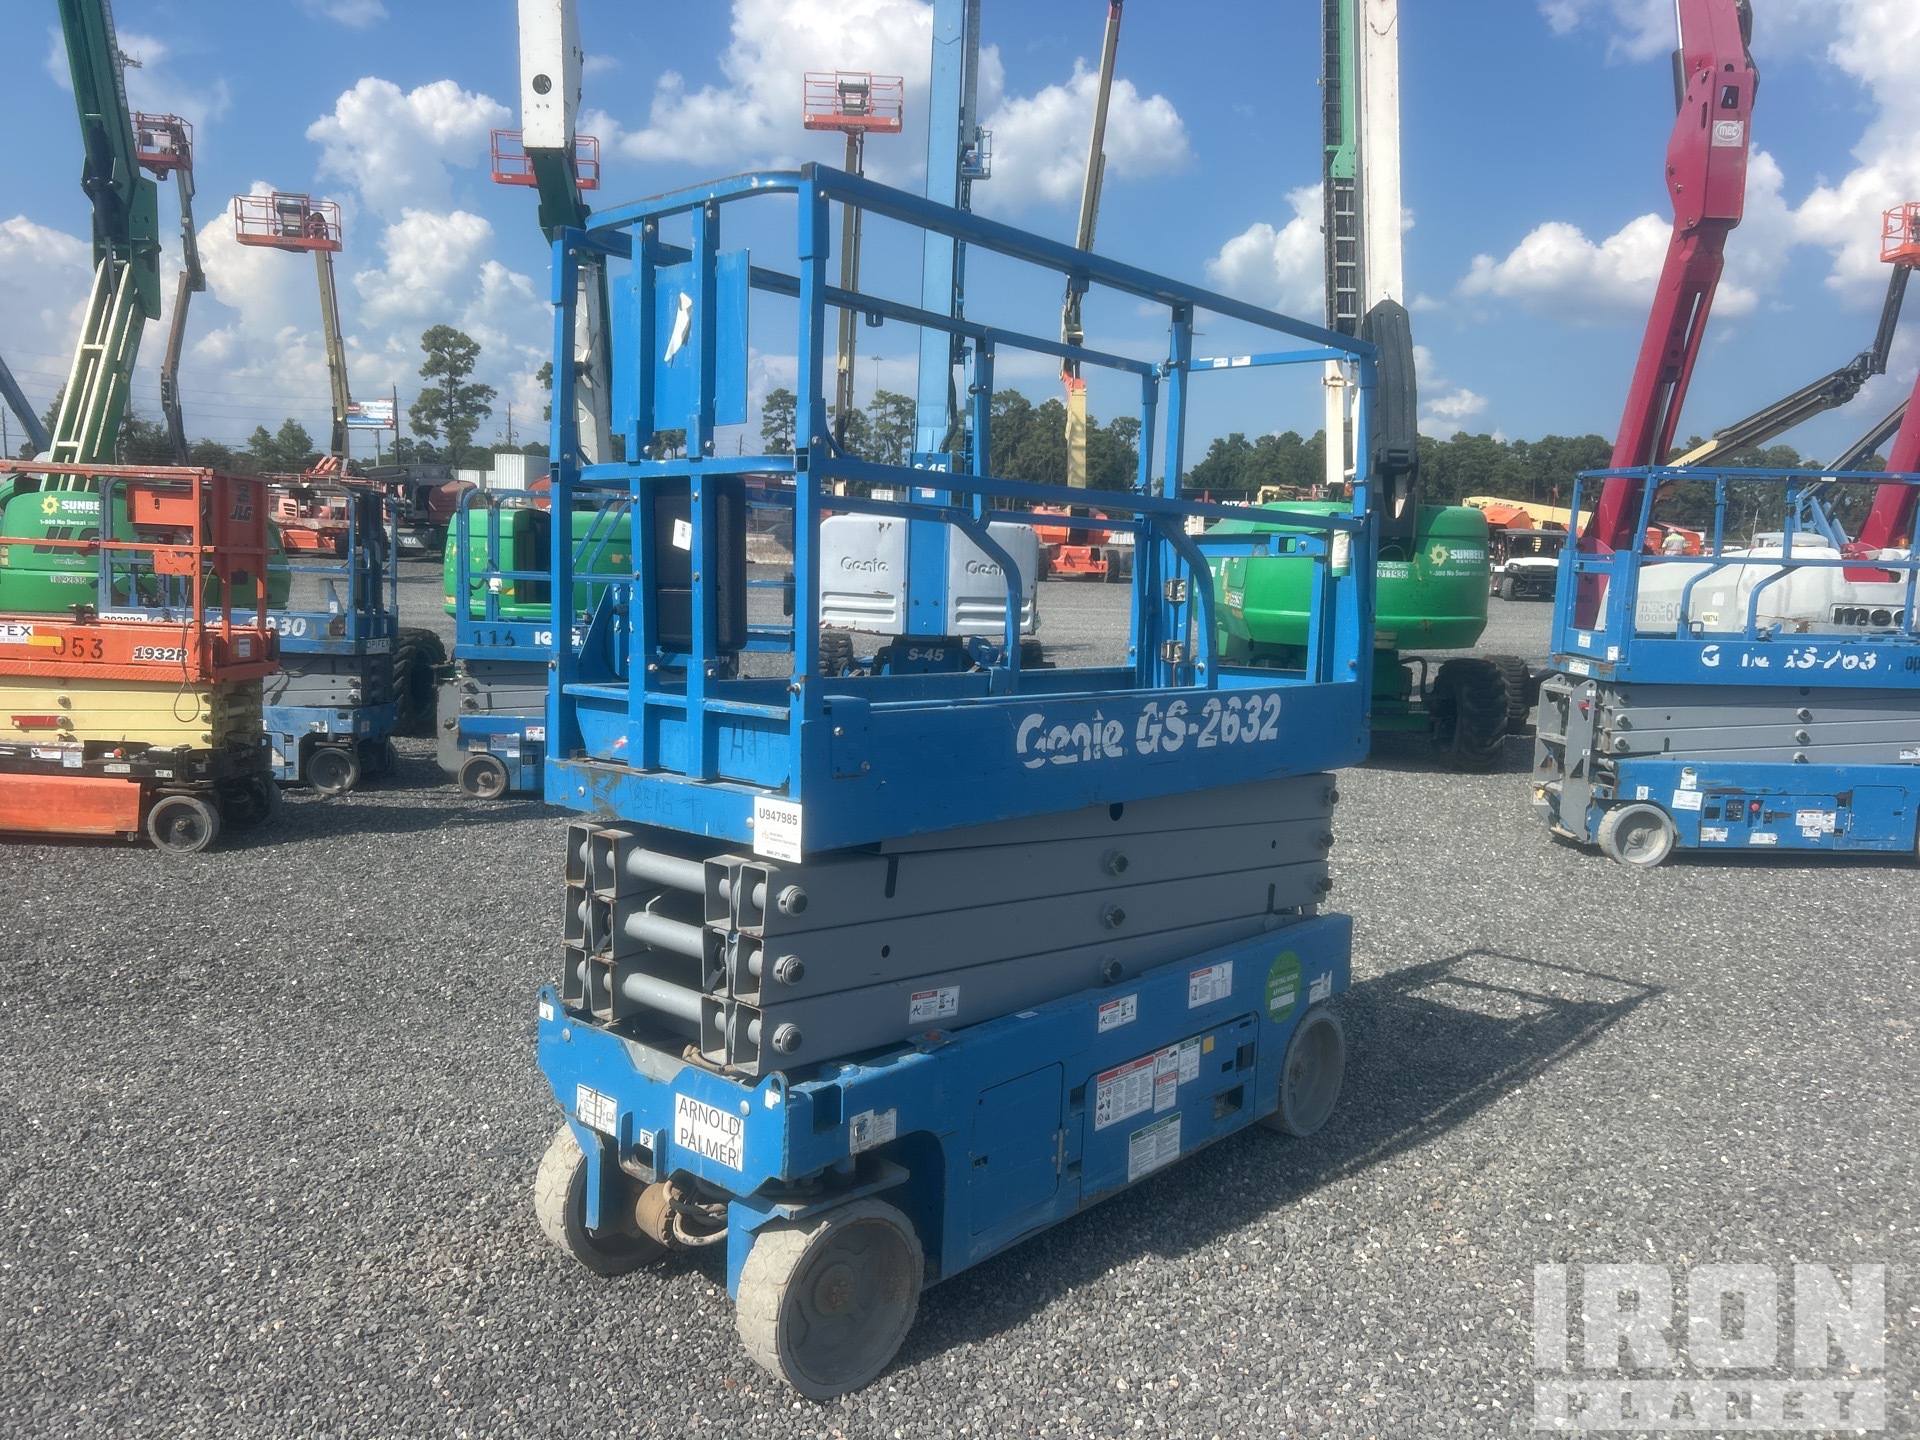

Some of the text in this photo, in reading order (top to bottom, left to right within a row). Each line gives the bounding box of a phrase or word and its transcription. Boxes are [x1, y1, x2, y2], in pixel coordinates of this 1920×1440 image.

[914, 463, 947, 474] S45
[61, 500, 100, 510] SUNBE
[230, 504, 253, 522] JLG
[1450, 549, 1485, 560] SUNBELT
[840, 556, 889, 573] Genie
[965, 559, 1004, 577] Geni
[366, 639, 390, 649] OPIFEX
[133, 646, 188, 662] 1932R
[907, 648, 945, 662] S-45
[1016, 693, 1282, 769] Genie GS-2632
[758, 807, 798, 826] U947985
[678, 1097, 740, 1136] ARNOLD
[680, 1127, 738, 1169] PALMER
